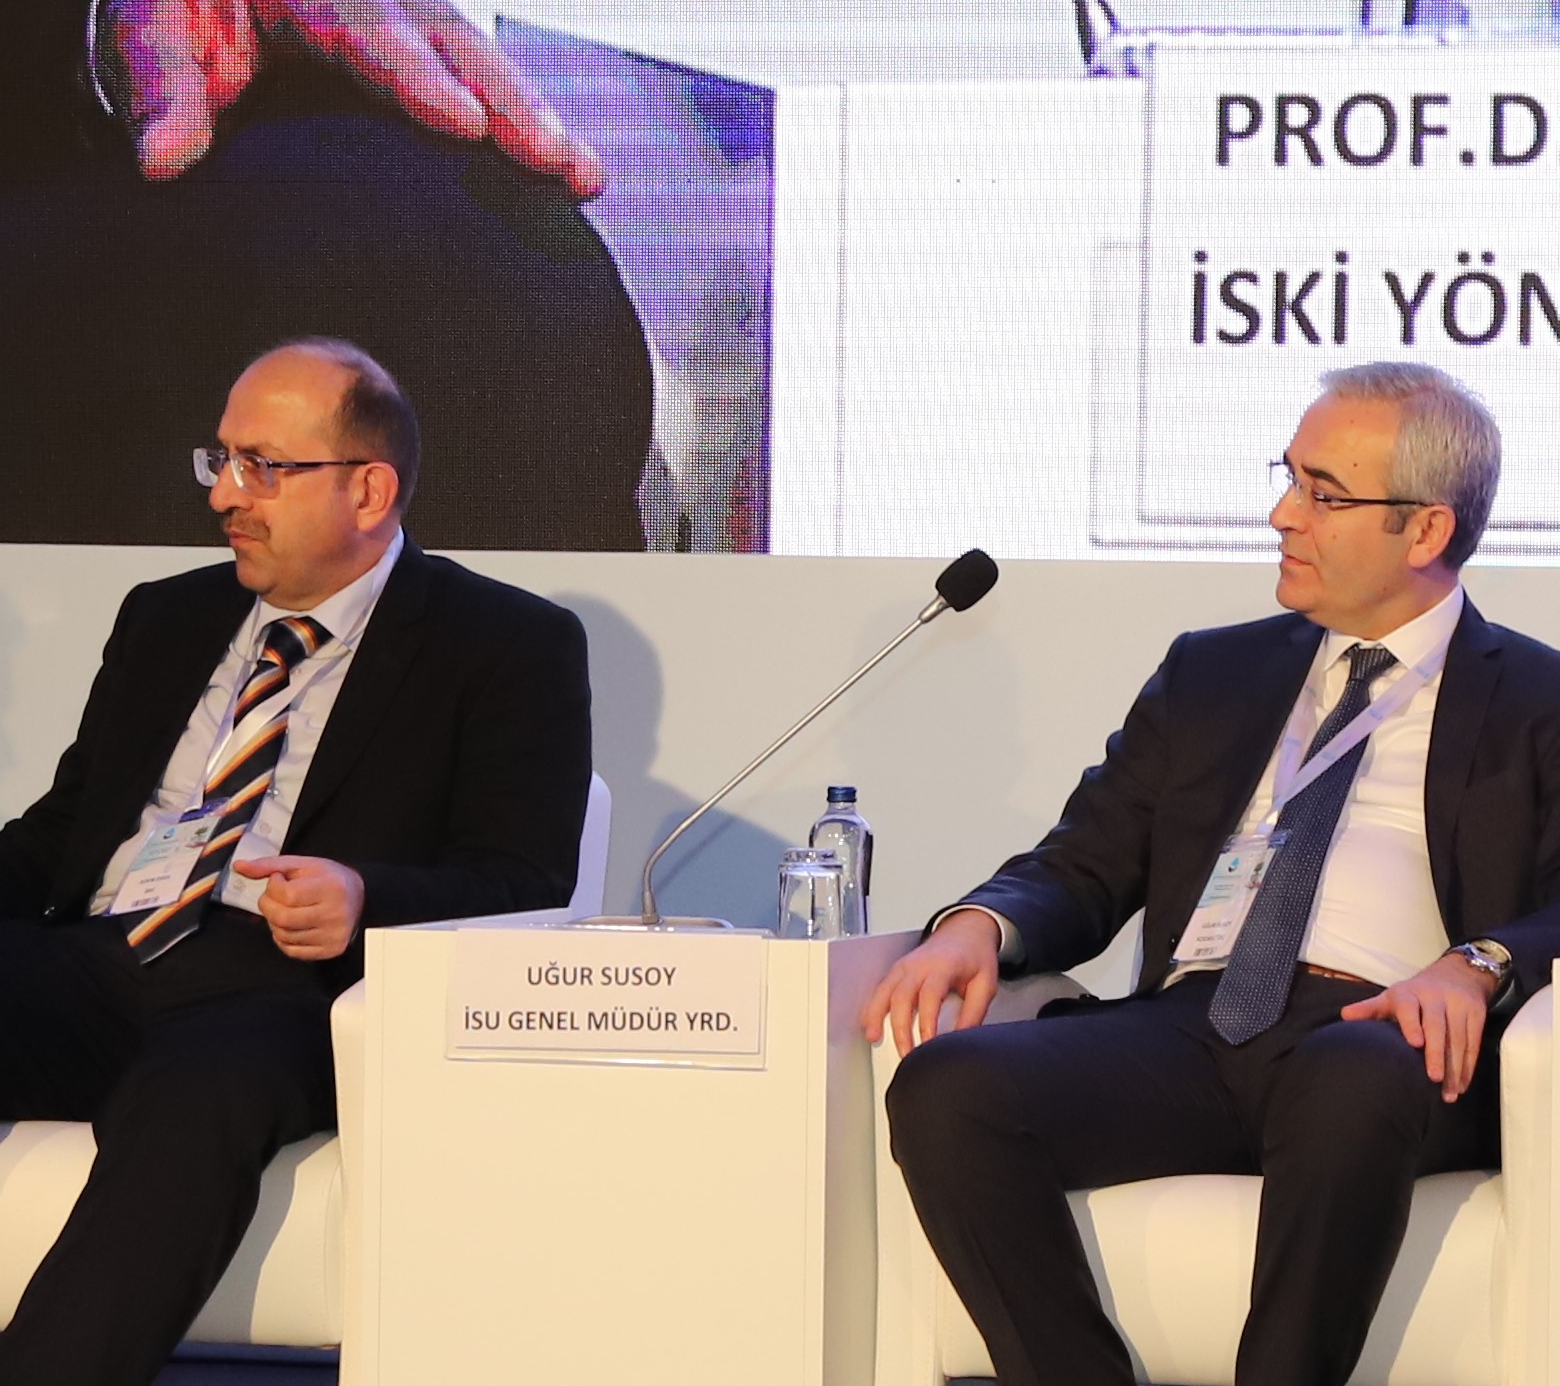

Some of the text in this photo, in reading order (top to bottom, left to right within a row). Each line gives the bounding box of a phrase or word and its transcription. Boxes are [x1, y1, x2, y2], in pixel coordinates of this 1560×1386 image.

[1187, 249, 1351, 348] İSKİ
[527, 961, 677, 986] UĞUR SUSOY
[464, 1006, 738, 1031] İSU GENEL MÜDÜR YRD.
